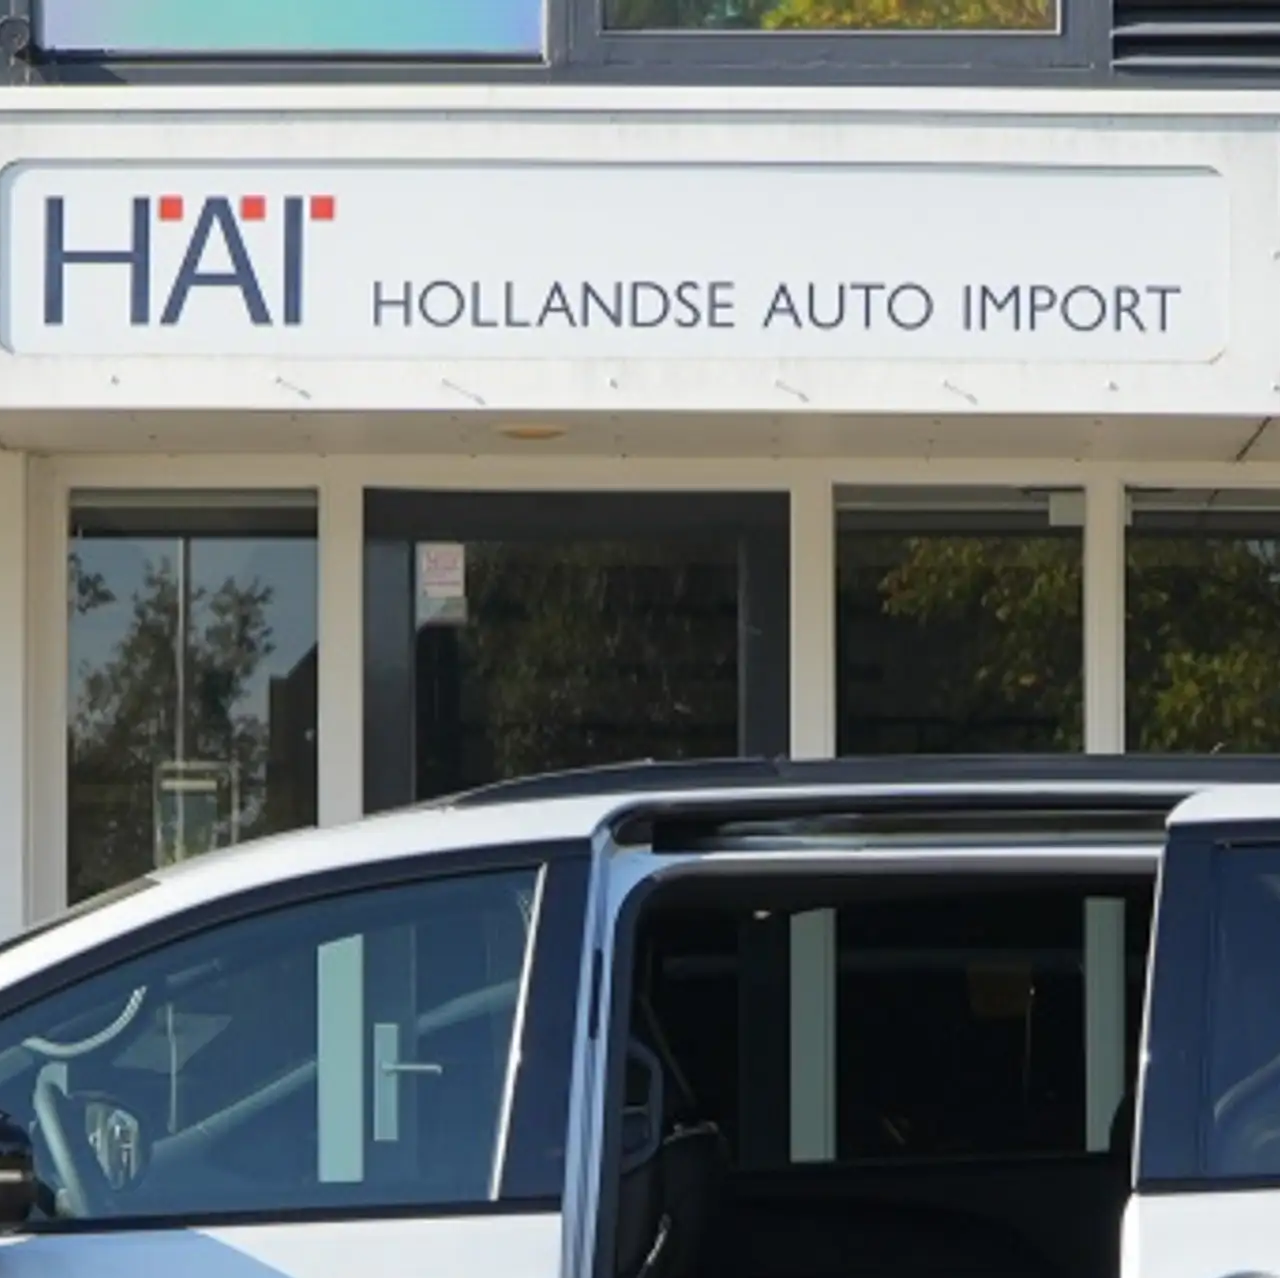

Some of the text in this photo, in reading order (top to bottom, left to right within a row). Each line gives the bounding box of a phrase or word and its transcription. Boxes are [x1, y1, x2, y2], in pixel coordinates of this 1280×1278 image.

[372, 280, 1182, 332] HOLLANDSE AUTO IMPORT
